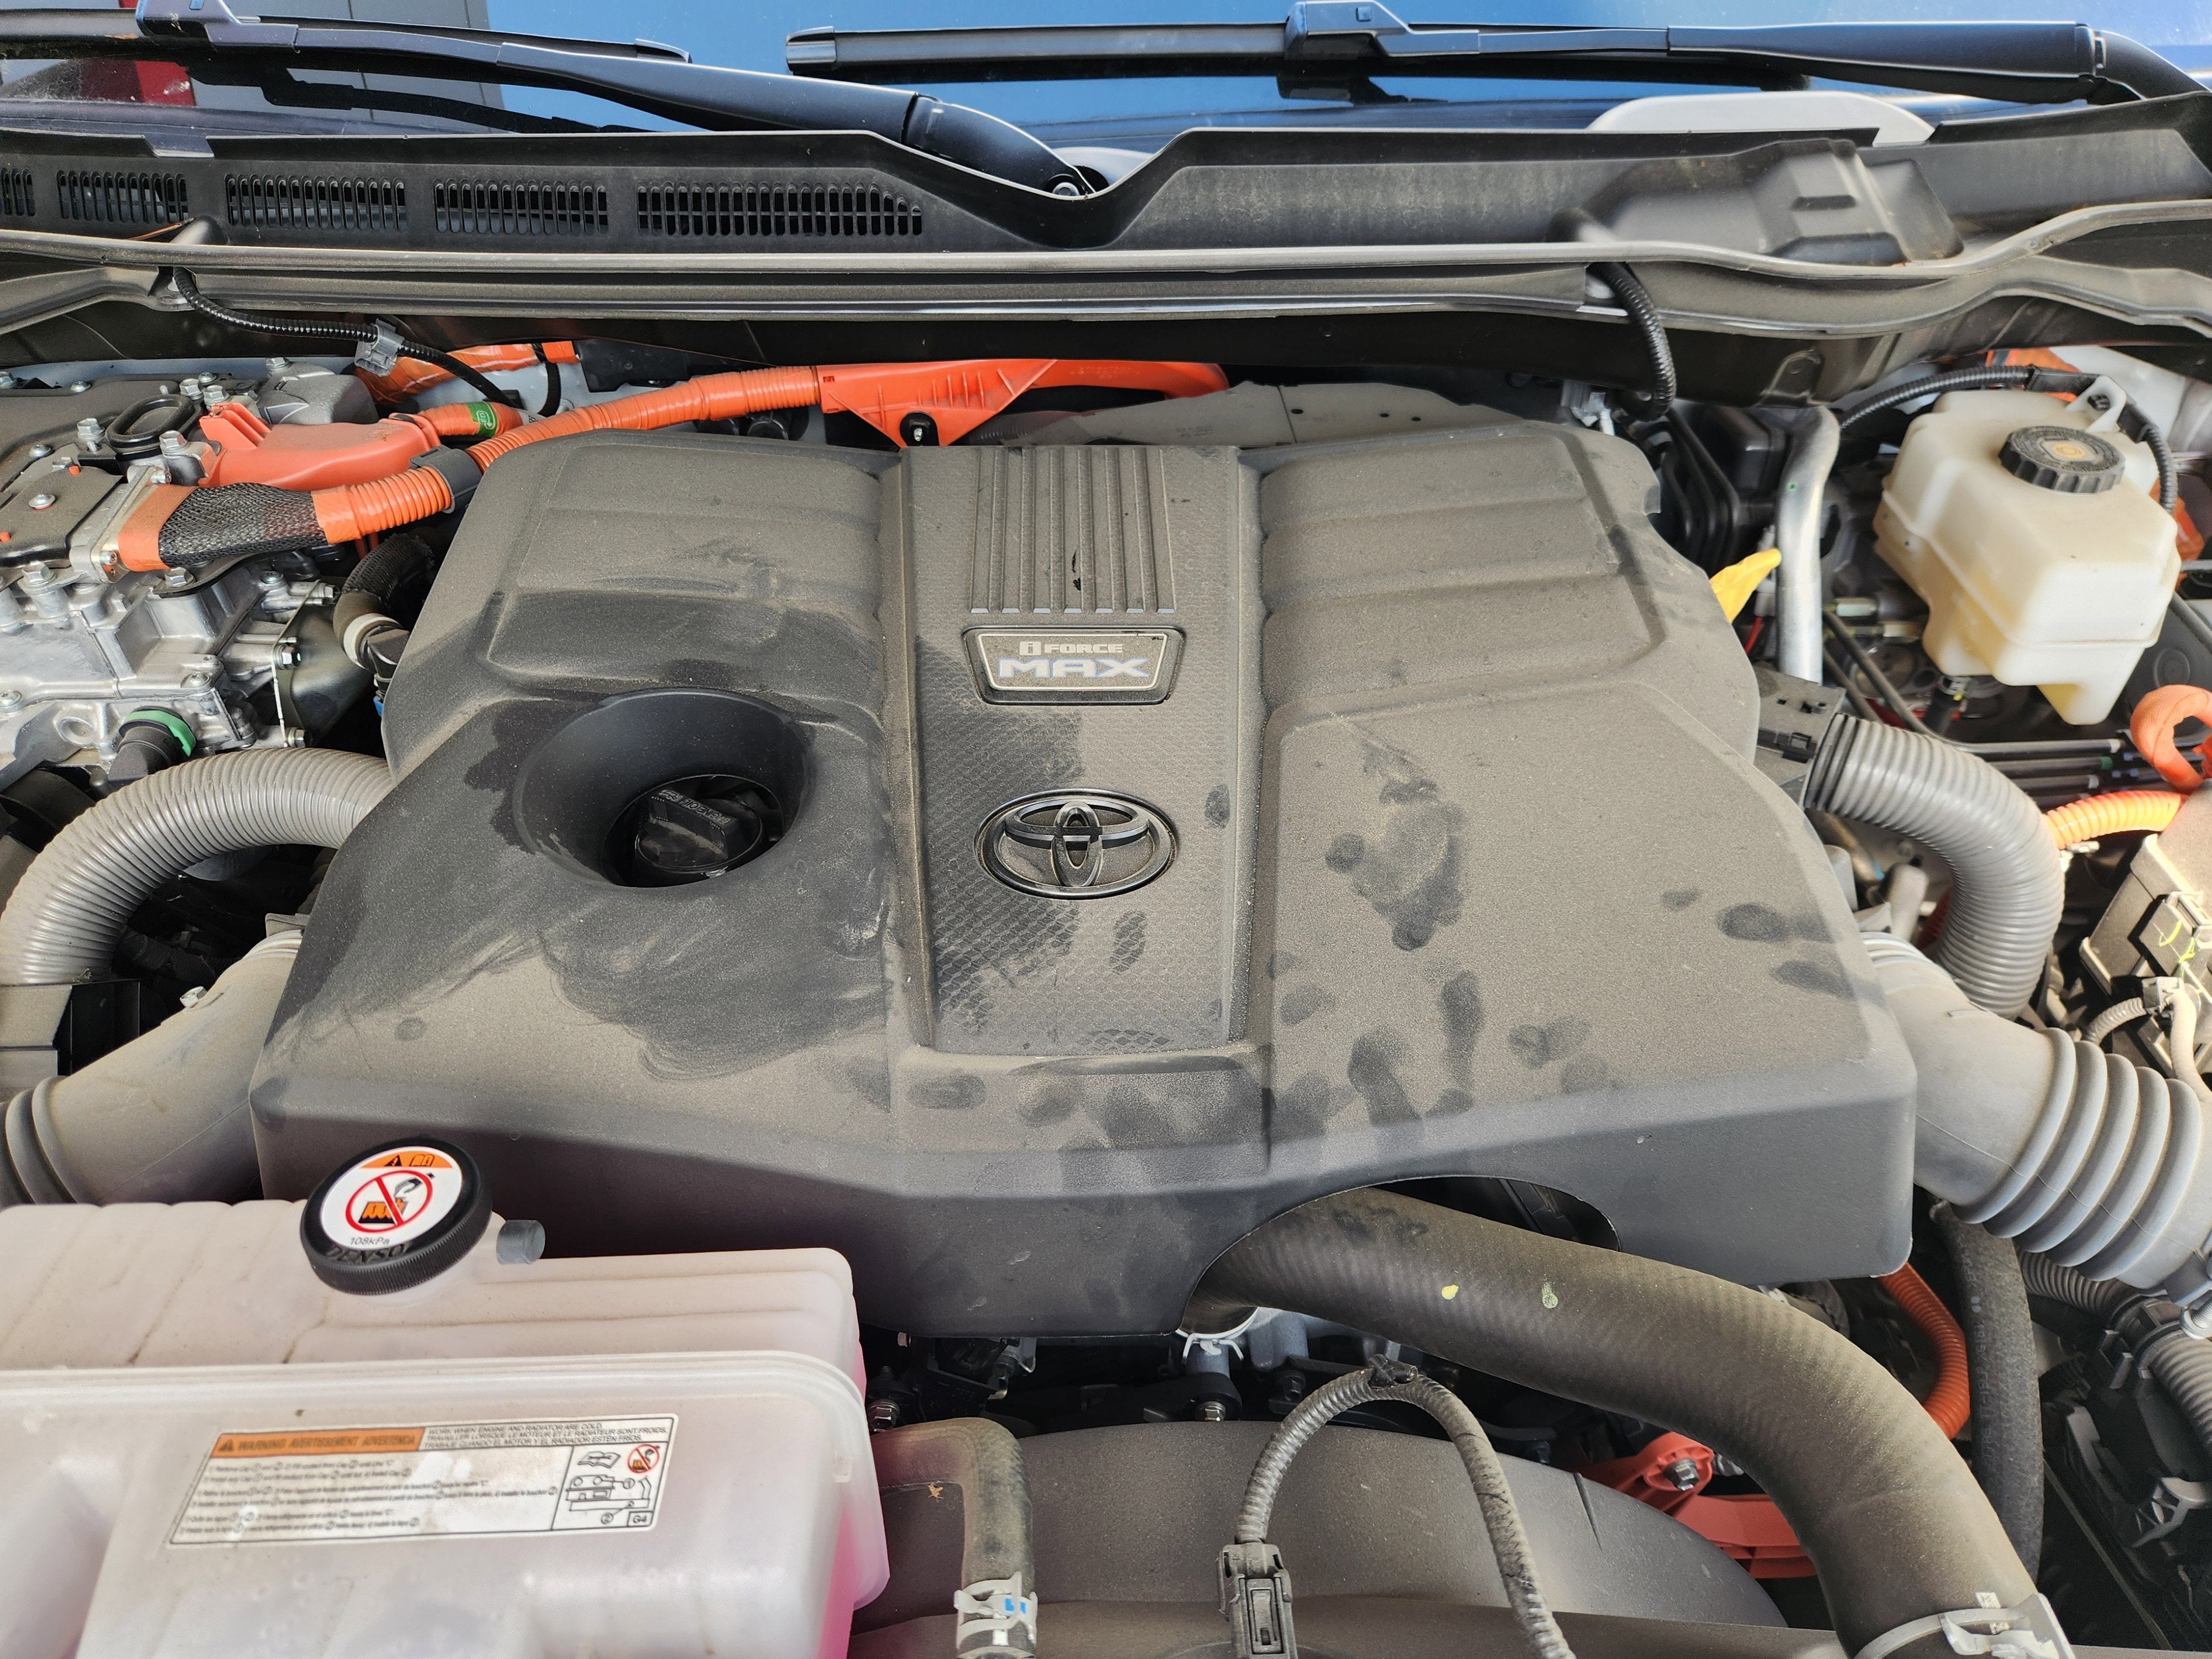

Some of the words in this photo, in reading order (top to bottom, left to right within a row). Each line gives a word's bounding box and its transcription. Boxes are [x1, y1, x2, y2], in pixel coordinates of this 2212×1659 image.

[1044, 643, 1123, 654] FORCE
[997, 658, 1150, 678] MAX
[684, 798, 699, 811] OIL
[697, 806, 732, 825] ENGINE
[350, 1237, 389, 1245] 108kPa
[633, 1515, 647, 1524] G4
